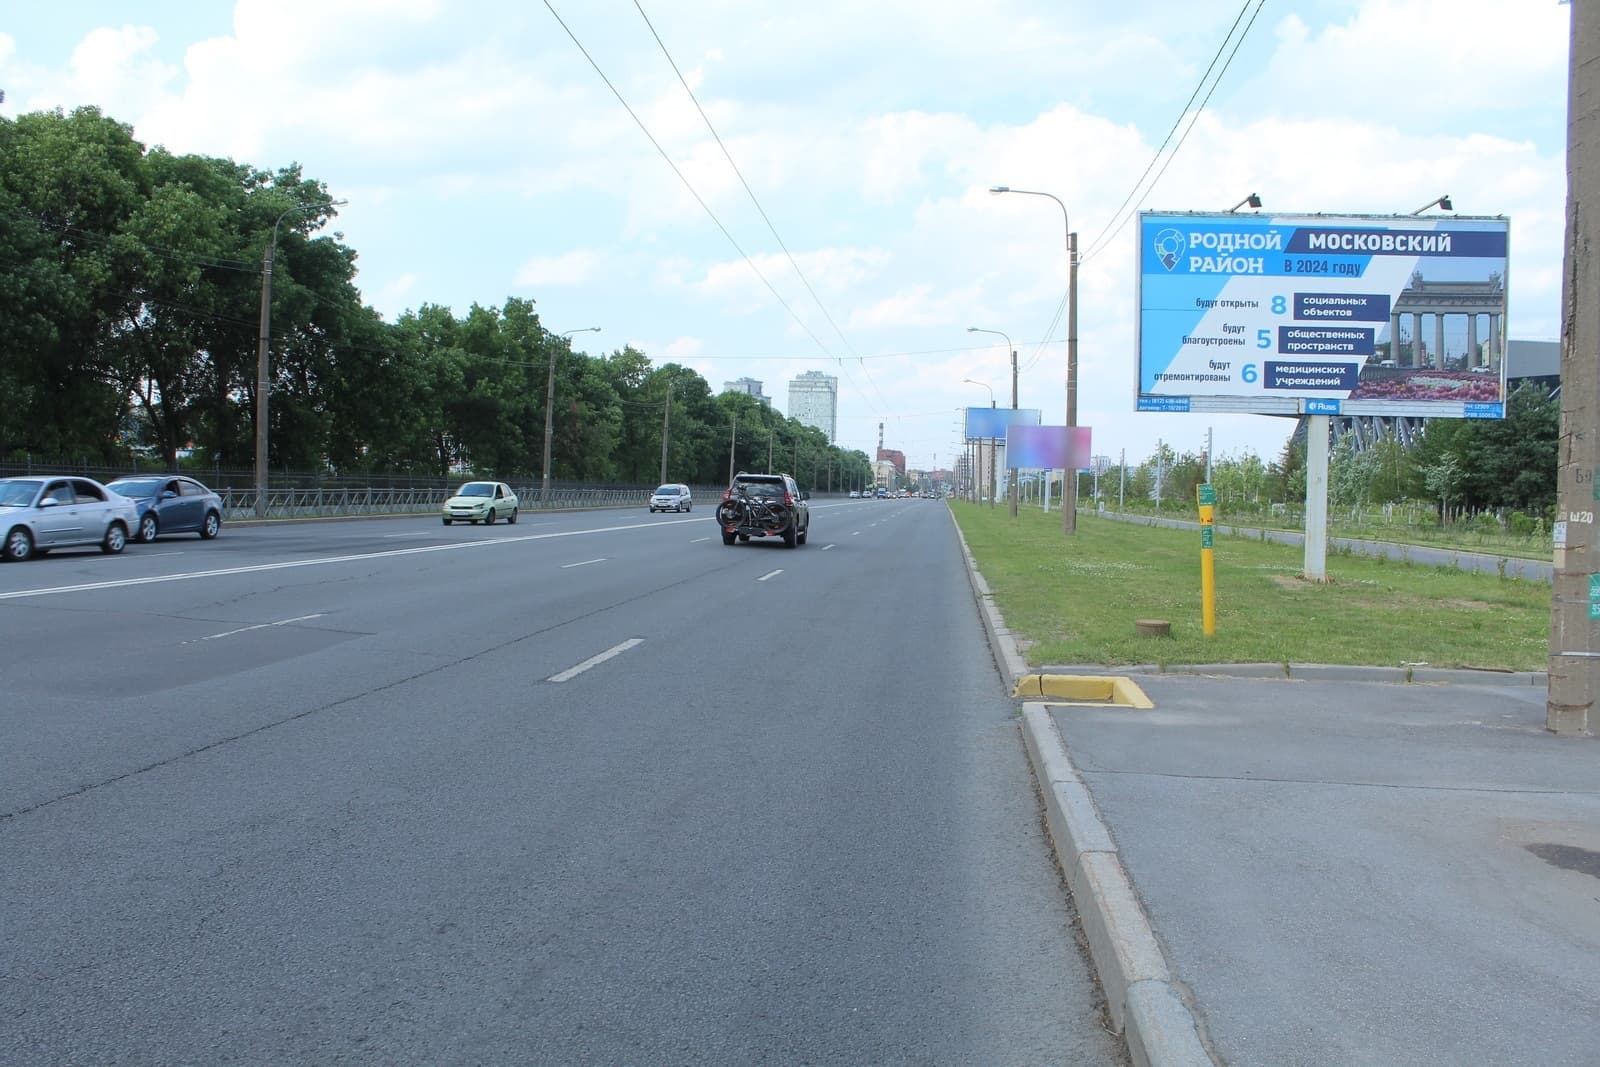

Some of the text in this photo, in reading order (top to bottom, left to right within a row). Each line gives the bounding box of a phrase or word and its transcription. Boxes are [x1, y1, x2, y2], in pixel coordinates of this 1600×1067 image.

[1189, 230, 1282, 253] РОДНОЙ
[1308, 232, 1452, 253] МОСКОВСКИЙ
[1189, 253, 1264, 274] РАЙОН
[1296, 260, 1328, 273] 2024
[1332, 264, 1361, 278] году
[1195, 297, 1259, 310] будут открыты
[1270, 295, 1287, 315] 8
[1303, 297, 1367, 306] социальных
[1303, 308, 1352, 317] объектов
[1222, 323, 1245, 334] будут
[1287, 329, 1365, 340] общественных
[1182, 335, 1246, 347] благоустроены
[1256, 329, 1272, 349] 5
[1287, 342, 1354, 352] пространств
[1208, 359, 1231, 371] будут
[1275, 366, 1346, 376] медицинских
[1153, 372, 1231, 383] отремонтированы
[1241, 363, 1258, 384] 6
[1275, 377, 1341, 386] учреждений
